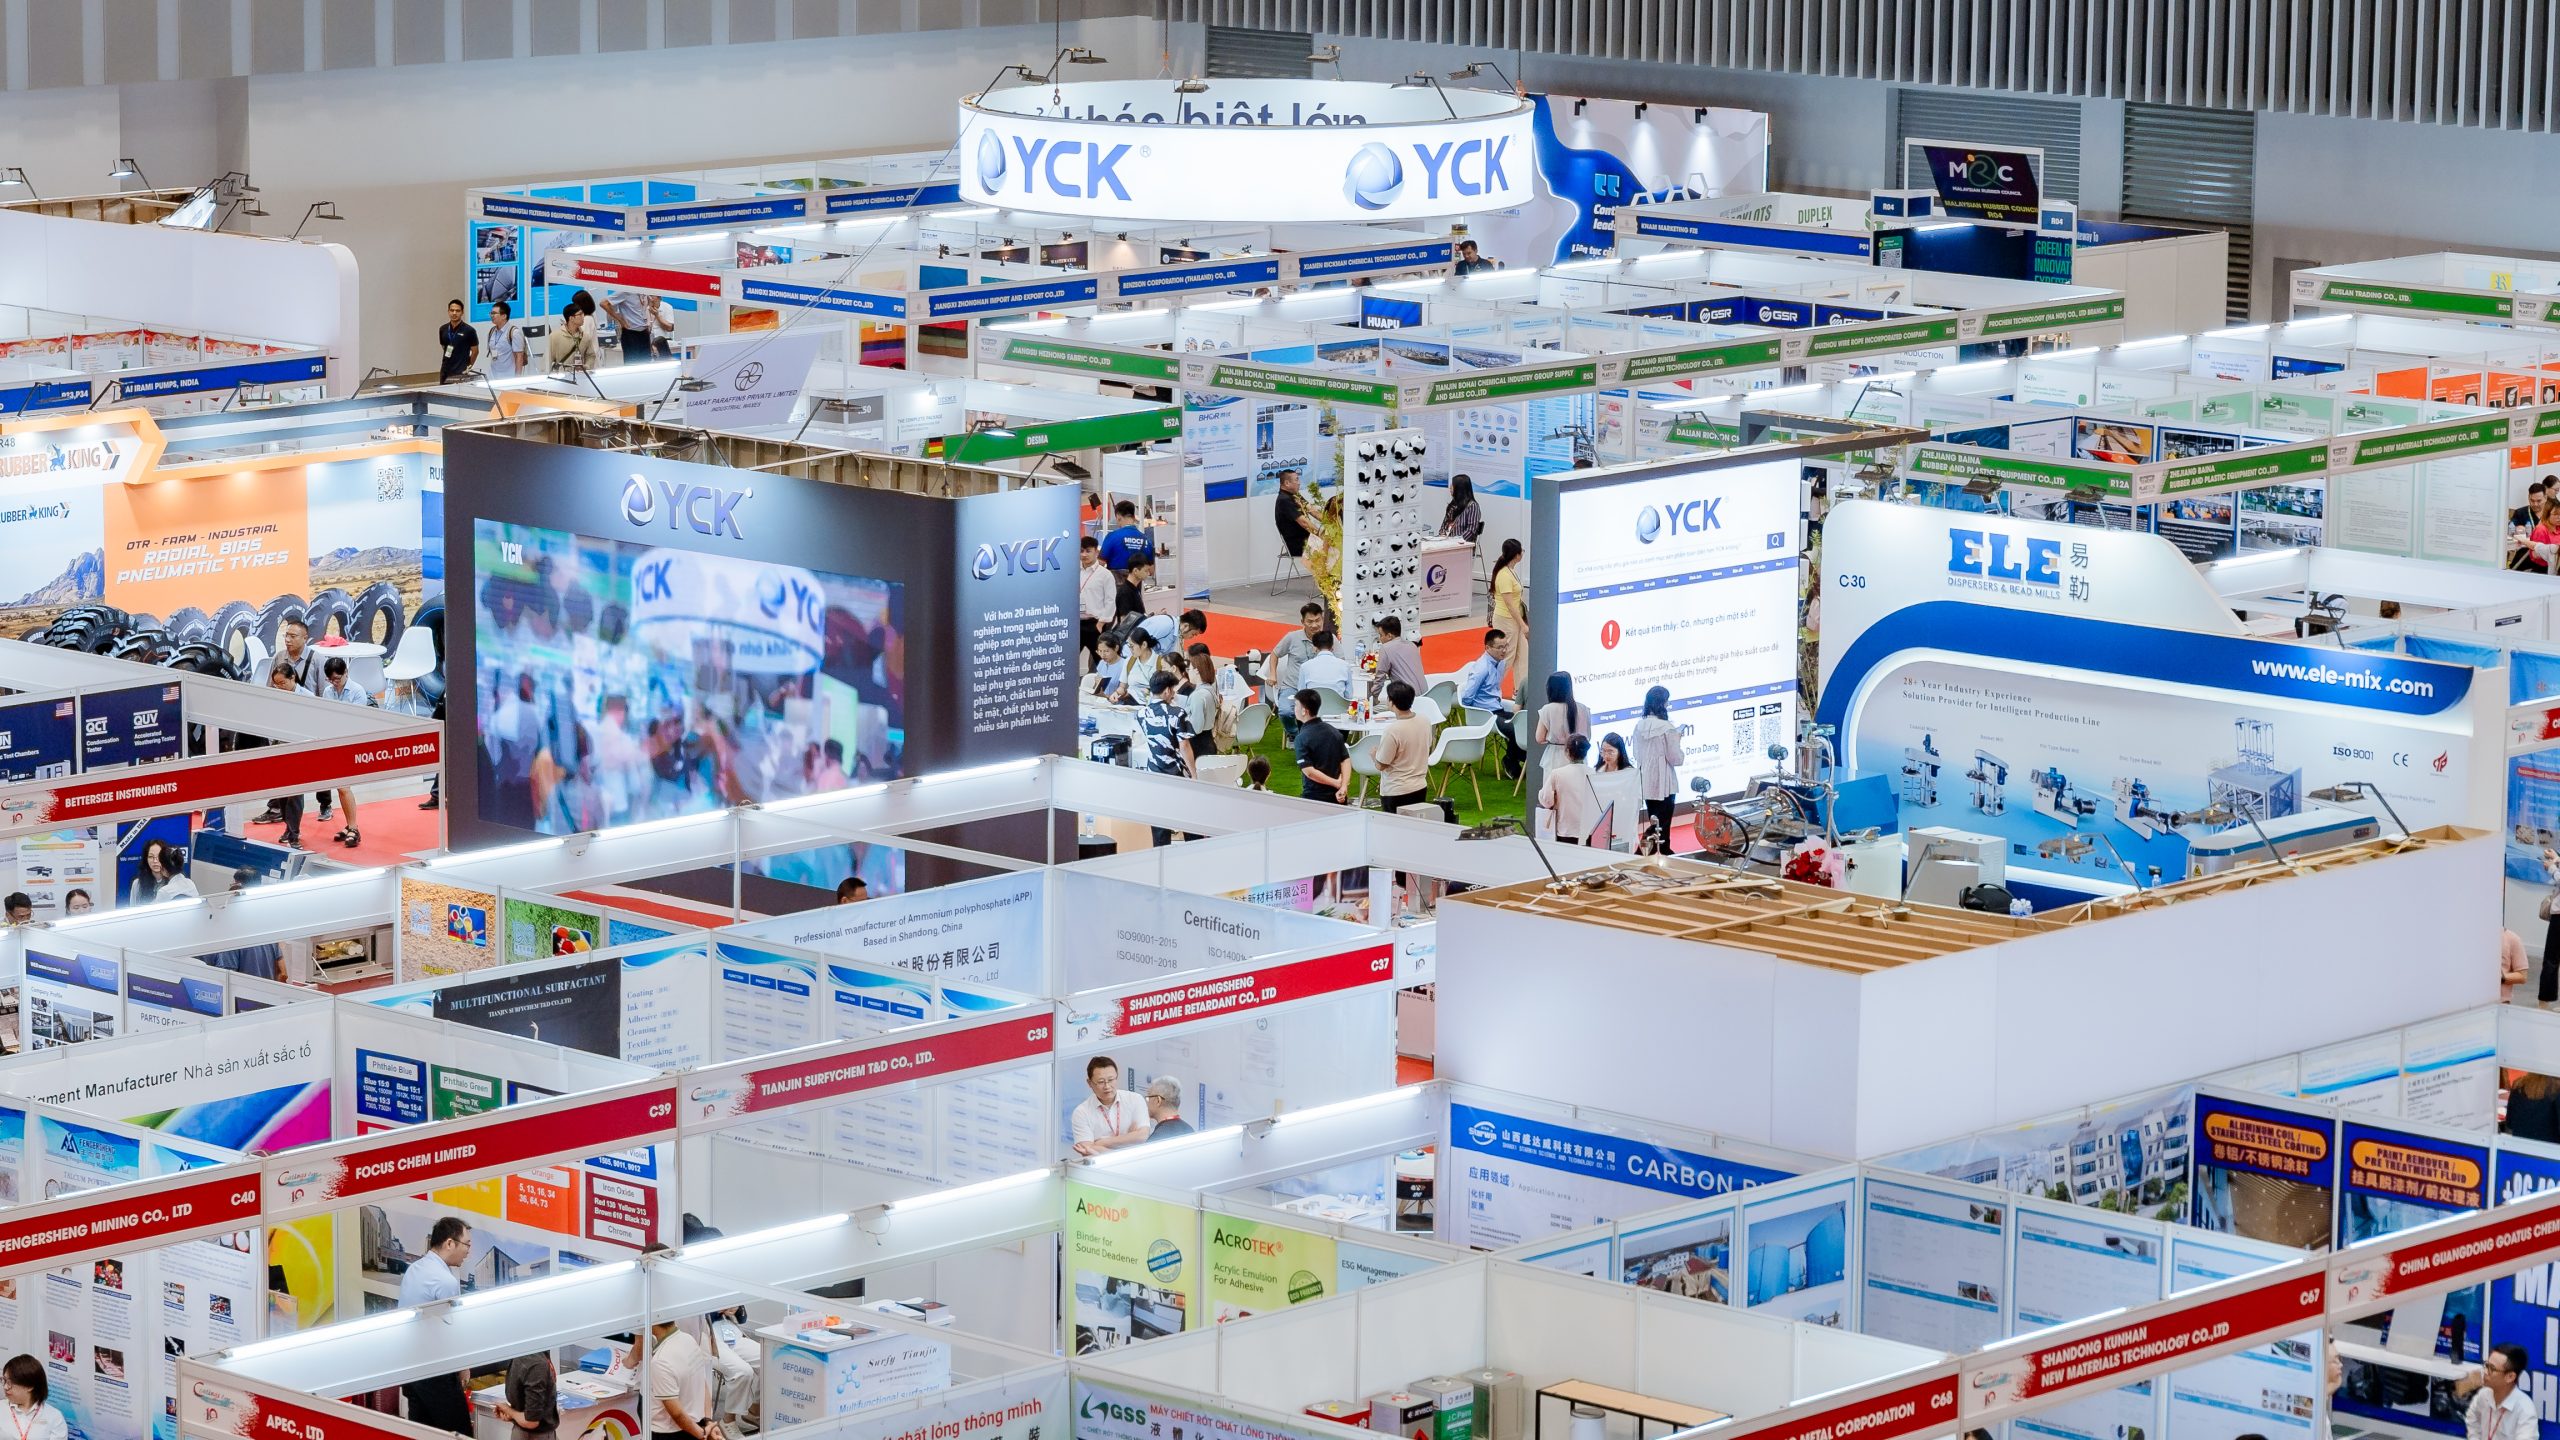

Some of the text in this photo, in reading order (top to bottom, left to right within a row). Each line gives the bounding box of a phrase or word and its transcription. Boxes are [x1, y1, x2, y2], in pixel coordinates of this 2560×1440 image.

[1012, 136, 1132, 201] YCK
[1414, 134, 1510, 200] YCK
[1798, 206, 1832, 224] DUPLEX
[2035, 241, 2062, 257] GREEN
[2355, 290, 2382, 298] TRADING
[2383, 293, 2397, 301] CO.,
[1368, 315, 1400, 329] HUAPU
[1711, 308, 1732, 319] GSR
[1773, 310, 1798, 322] GSR
[155, 381, 178, 389] PUMPS,
[1220, 367, 1372, 392] TIANJIN BOHAI CHEMICAL INDUSTRY GROUP SUPPLY
[1234, 378, 1251, 386] SALES
[1252, 381, 1275, 389] CO.,LTD
[1384, 393, 1396, 401] R53
[1164, 417, 1179, 427] R52A
[1027, 434, 1048, 446] DESMA
[1922, 451, 1980, 464] ZHEJIANG BAINA
[2110, 479, 2129, 489] R12A
[0, 506, 58, 523] UBBER KING
[659, 480, 743, 539] YCK
[1665, 497, 1721, 535] YCK
[143, 538, 260, 563] RADIAL, BIAS
[501, 542, 522, 566] YCK
[1000, 536, 1061, 575] YCK
[1949, 527, 2061, 585] ELE
[117, 551, 288, 583] PNEUMATIC TYRES
[2070, 543, 2090, 601] 易勒
[984, 604, 1058, 621] Với hơn 20 năm kinh
[86, 719, 107, 734] QCT
[134, 712, 158, 727] QUV
[86, 736, 119, 747] Condensation
[134, 730, 162, 739] Accelerated
[355, 743, 434, 763] NQA CO., LTD R20A
[2333, 746, 2374, 761] ISO 9001
[65, 783, 177, 807] BETTERSIZE INSTRUMENTS
[794, 891, 1031, 943] Professional manufacturer of Ammonium polyphosphate (APP)
[1184, 910, 1260, 940] Certification
[1117, 950, 1177, 968] ISO45001-2018
[1371, 958, 1389, 972] C37
[451, 975, 605, 1009] MULTIFUNCTIONAL SURFACTANT
[627, 988, 654, 999] Coating
[1130, 977, 1254, 1010] SHANDONG CHANGSHENG
[627, 1003, 638, 1011] Ink
[1130, 987, 1277, 1025] NEW FLAME RETARDANT CO., LTD
[627, 1011, 657, 1024] Adhesive
[627, 1025, 657, 1037] Cleaning
[1027, 1027, 1048, 1041] C38
[627, 1038, 652, 1049] Textile
[27, 1040, 311, 1105] gment Manufacturer Nhà sản xuất sắc tố
[373, 1061, 412, 1075] Phthalo Blue
[761, 1052, 934, 1095] TIANJIN SURFYCHEM T&D CO., LTD.
[444, 1076, 487, 1091] Phthalo Green
[649, 1103, 671, 1118] C39
[2229, 1120, 2273, 1136] ALUMINUM
[2276, 1129, 2299, 1140] COIL
[1502, 1128, 1616, 1163] 山西盛达威科技有限公司
[2211, 1127, 2320, 1155] STAINLESS STEEL COATING
[356, 1145, 475, 1178] FOCUS CHEM LIMITED
[2377, 1149, 2402, 1160] PAINT
[2406, 1154, 2448, 1168] REMOVER
[1469, 1166, 1509, 1187] 应用领域
[1628, 1155, 1732, 1192] CARBON
[2364, 1157, 2466, 1183] PRE TREATMENT FLUID
[231, 1190, 255, 1205] C40
[603, 1183, 634, 1197] Iron Oxide
[0, 1204, 193, 1251] FENGERSHENG MINING CO., LTD
[608, 1226, 632, 1237] Chrome
[1076, 1231, 1112, 1246] Binder for
[1076, 1243, 1137, 1264] Sound Deadener
[2399, 1257, 2429, 1275] CHINA
[2432, 1239, 2493, 1265] GUANGDONG
[2496, 1229, 2531, 1247] GOATUS
[1214, 1262, 1277, 1283] Acrylic Emulsion
[1214, 1275, 1263, 1292] For Adhesive
[2300, 1289, 2319, 1305] C67
[2041, 1323, 2228, 1386] NEW MATERIALS TECHNOLOGY CO.,LTD
[2042, 1327, 2146, 1367] SHANDONG KUNHAN
[1931, 1392, 1953, 1408] C68
[1111, 1403, 1146, 1426] GSS
